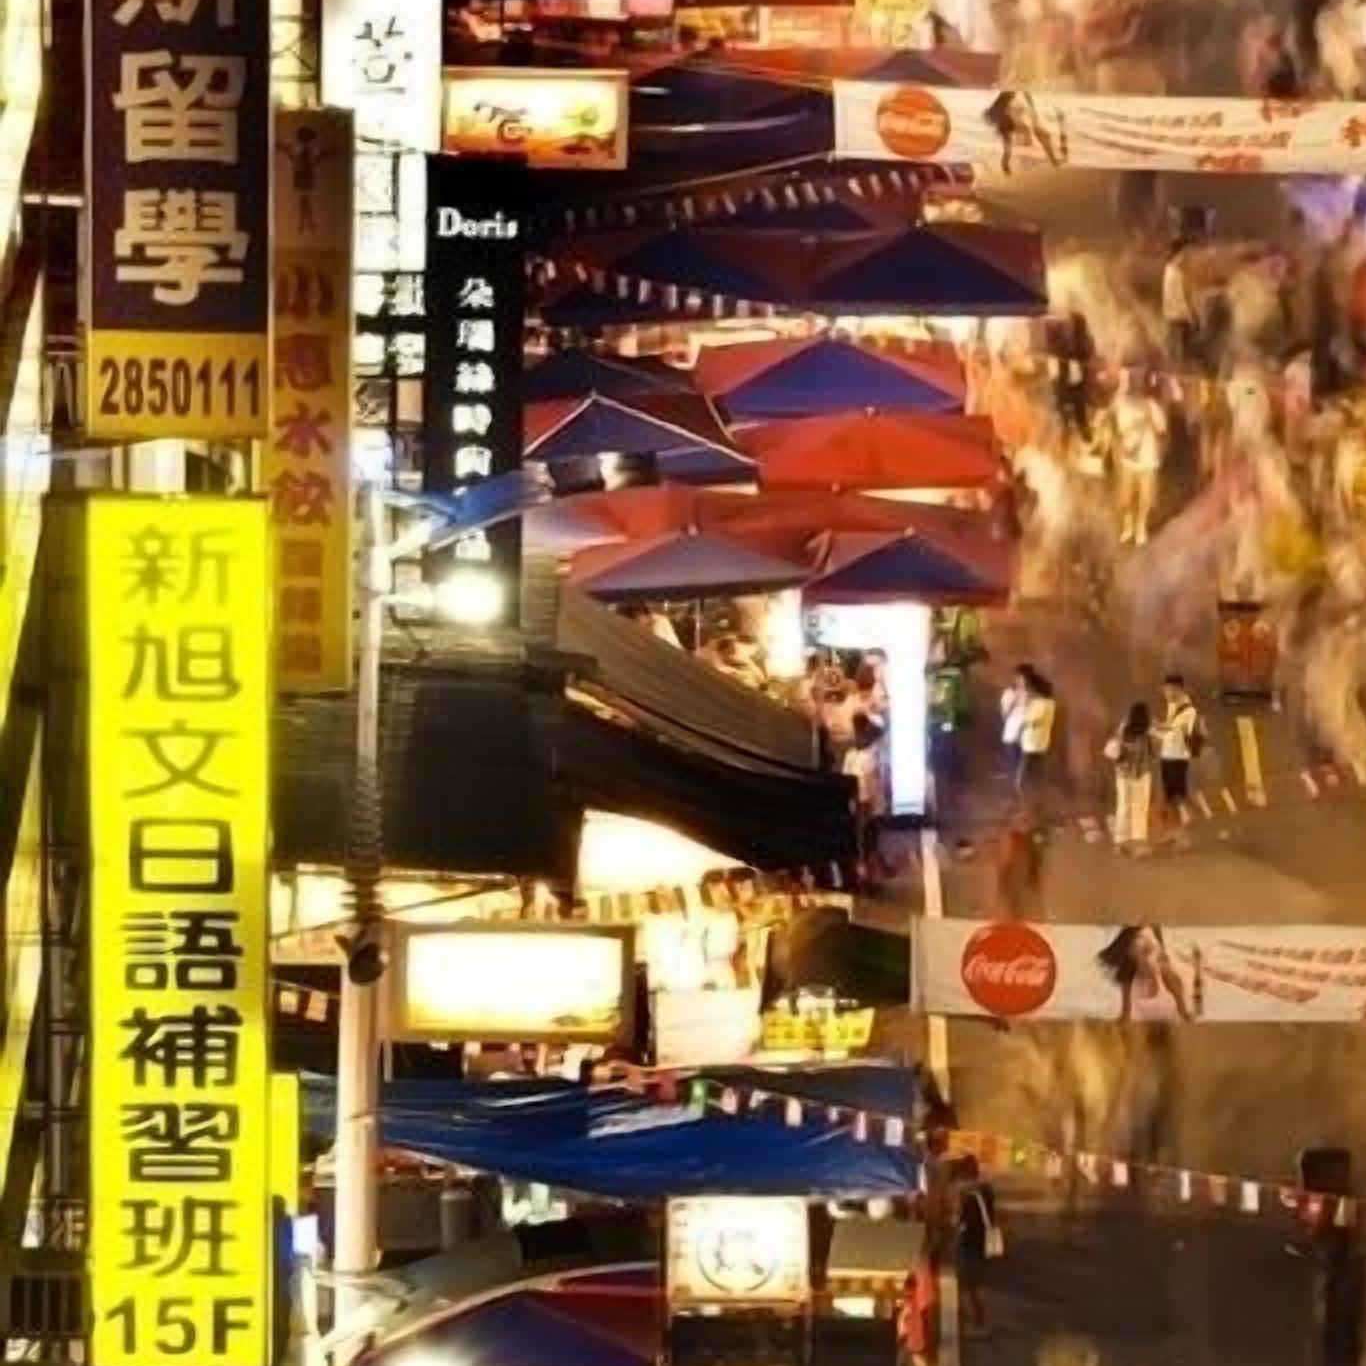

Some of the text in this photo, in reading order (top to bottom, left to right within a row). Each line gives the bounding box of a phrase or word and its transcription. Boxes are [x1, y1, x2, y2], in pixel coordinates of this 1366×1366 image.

[437, 207, 519, 239] Doris
[98, 356, 262, 418] 2850111
[118, 524, 245, 1278] 新旭文日語補習班
[103, 1295, 254, 1356] 15F
